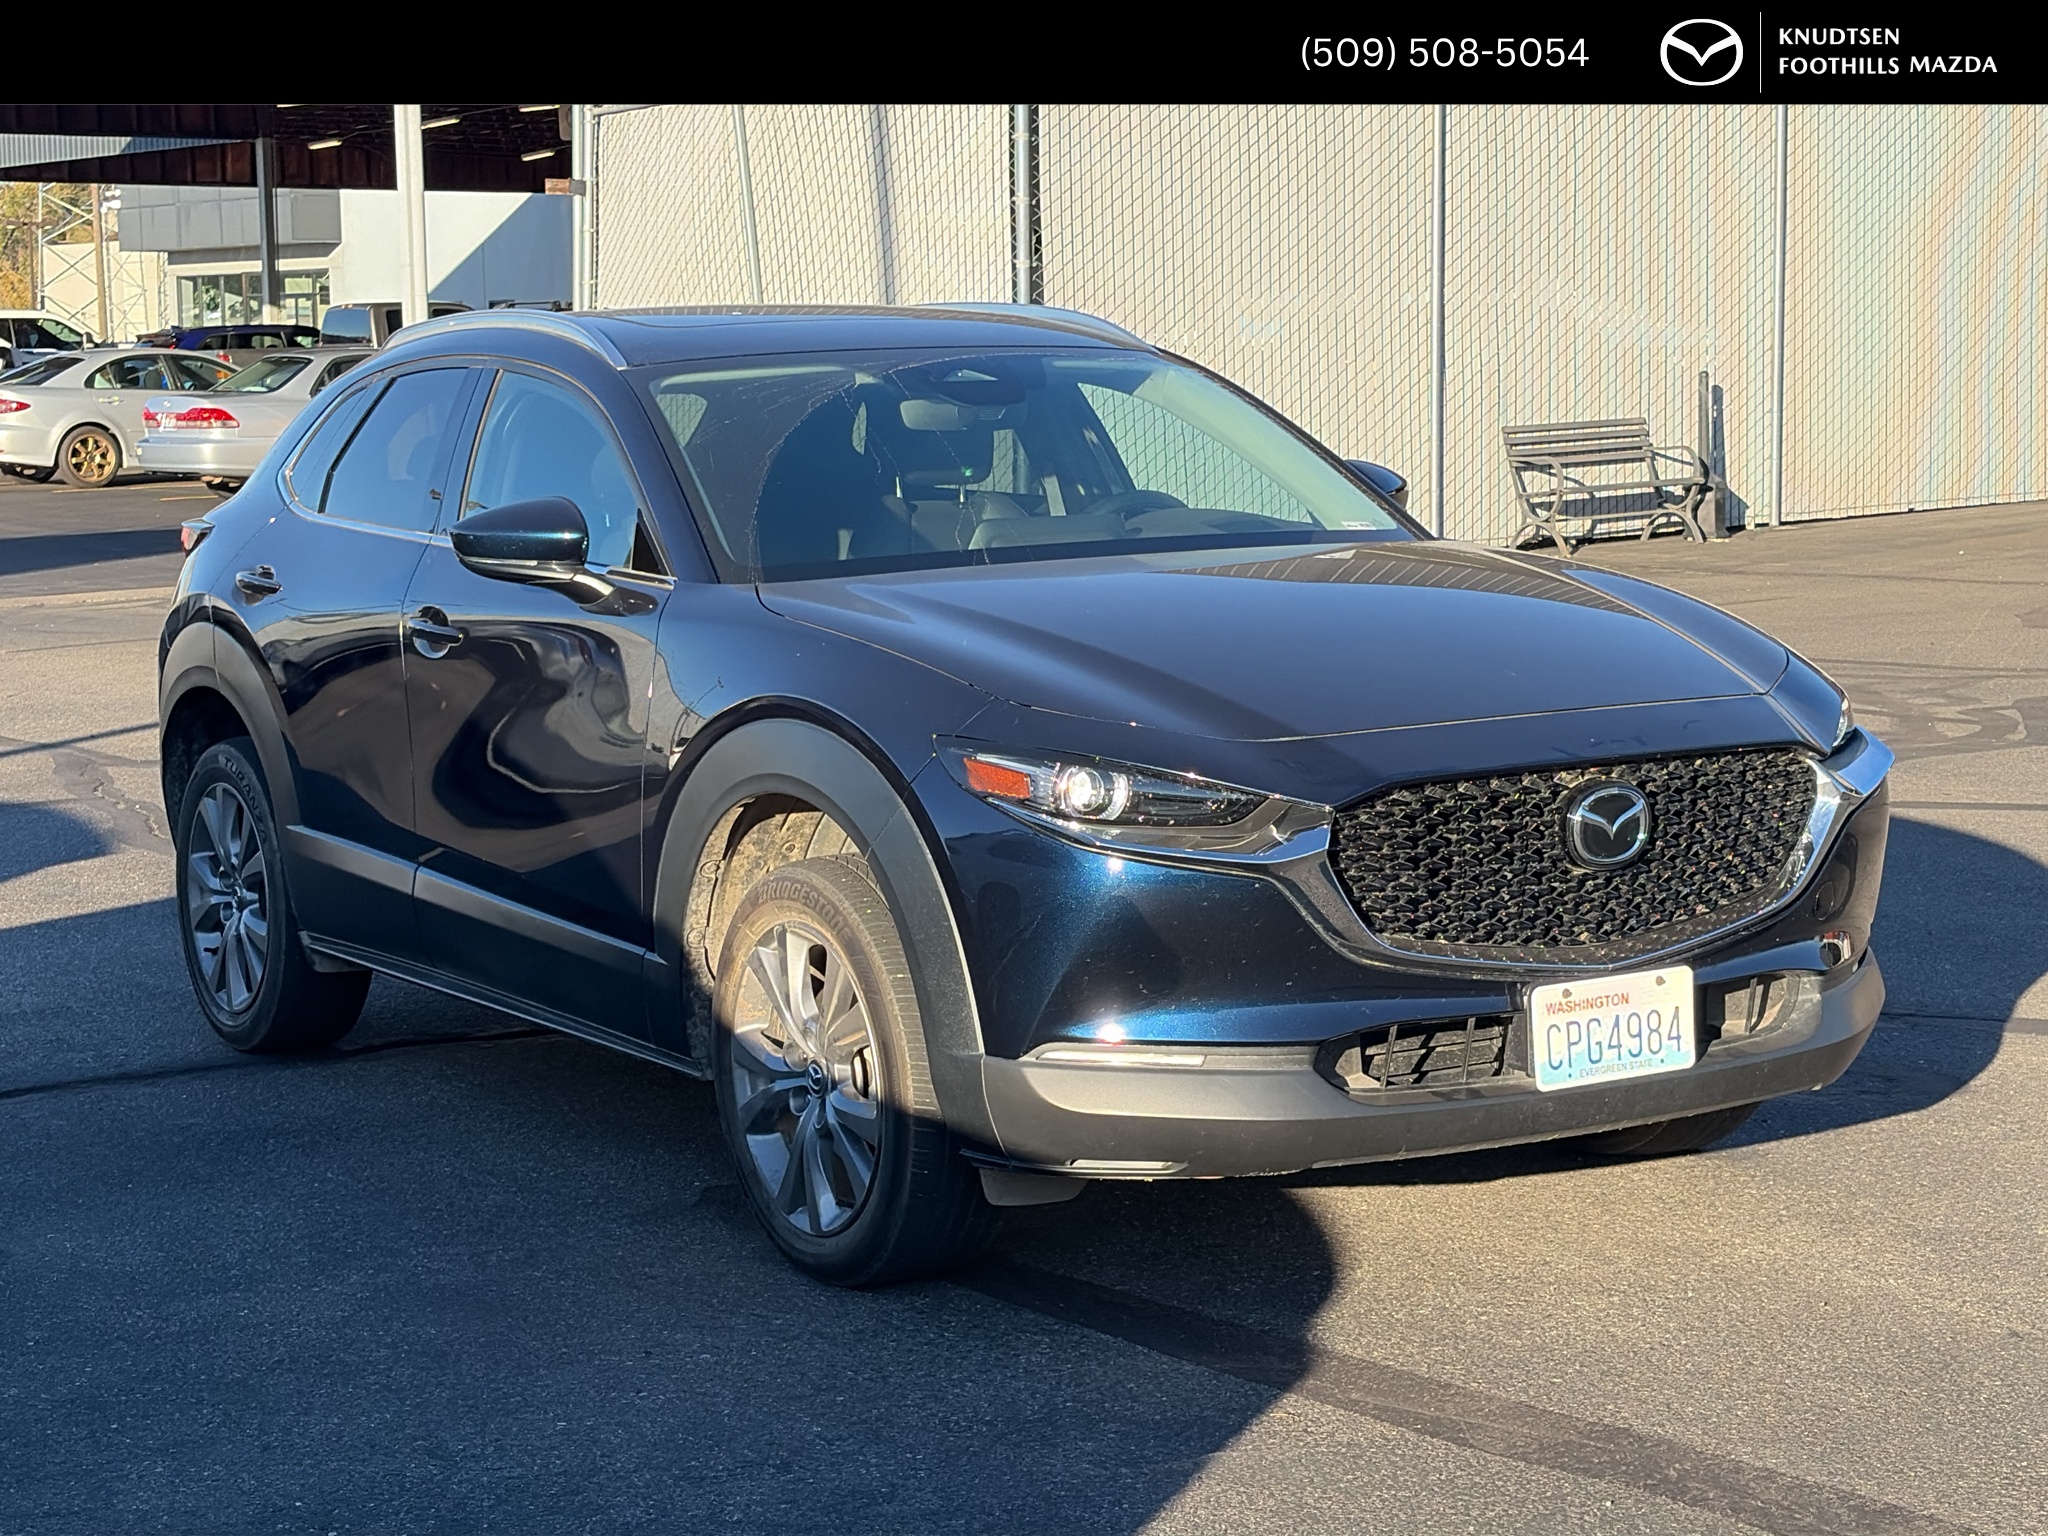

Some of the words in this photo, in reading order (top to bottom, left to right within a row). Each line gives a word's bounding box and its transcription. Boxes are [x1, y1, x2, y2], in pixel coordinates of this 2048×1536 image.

[1545, 992, 1630, 1016] WASHINGTON
[1546, 1005, 1682, 1071] CPG4984
[1579, 1063, 1628, 1078] EVERGREEN
[1629, 1058, 1653, 1071] STATE
